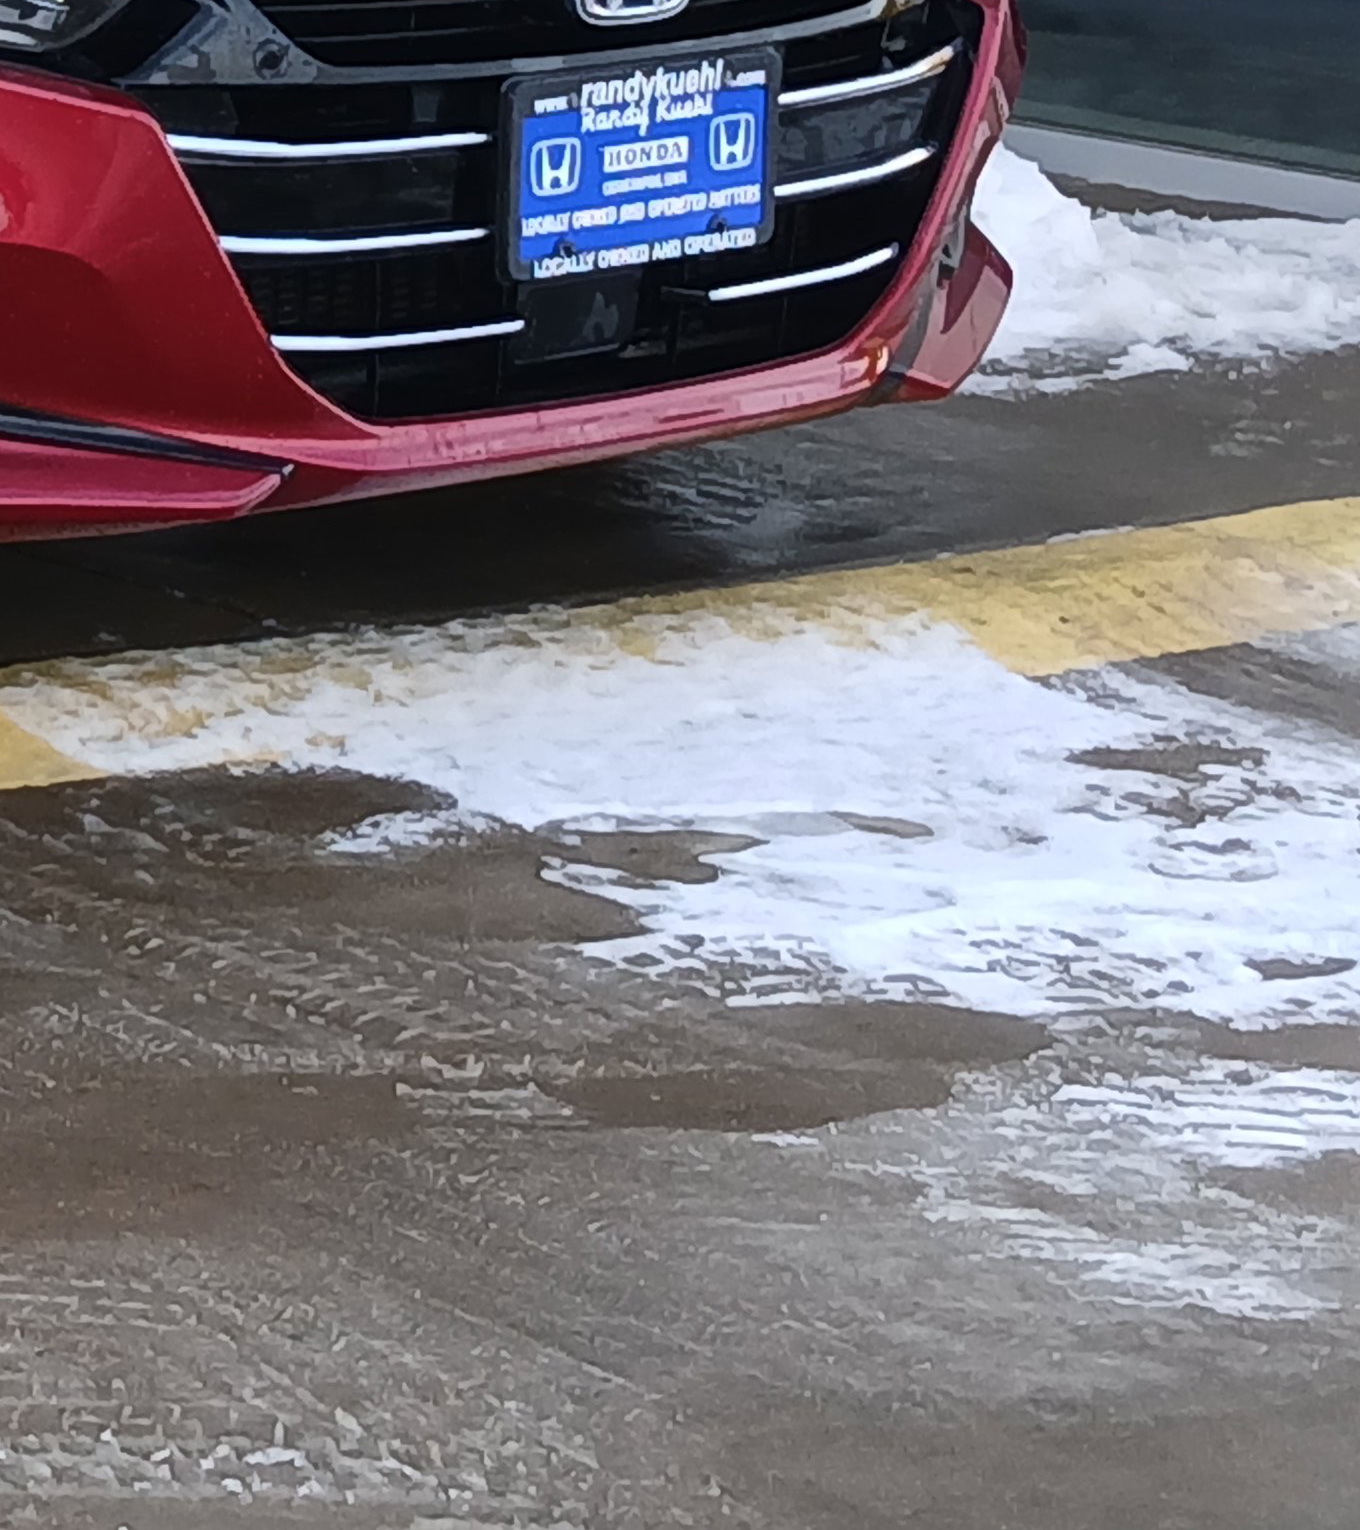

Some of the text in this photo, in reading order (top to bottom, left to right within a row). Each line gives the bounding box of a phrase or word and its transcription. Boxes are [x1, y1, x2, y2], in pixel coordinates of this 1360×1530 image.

[581, 93, 713, 137] Randy Kuehl
[608, 141, 683, 167] HONDA
[533, 227, 757, 279] LOCALLY OWNED AND OPERATED
